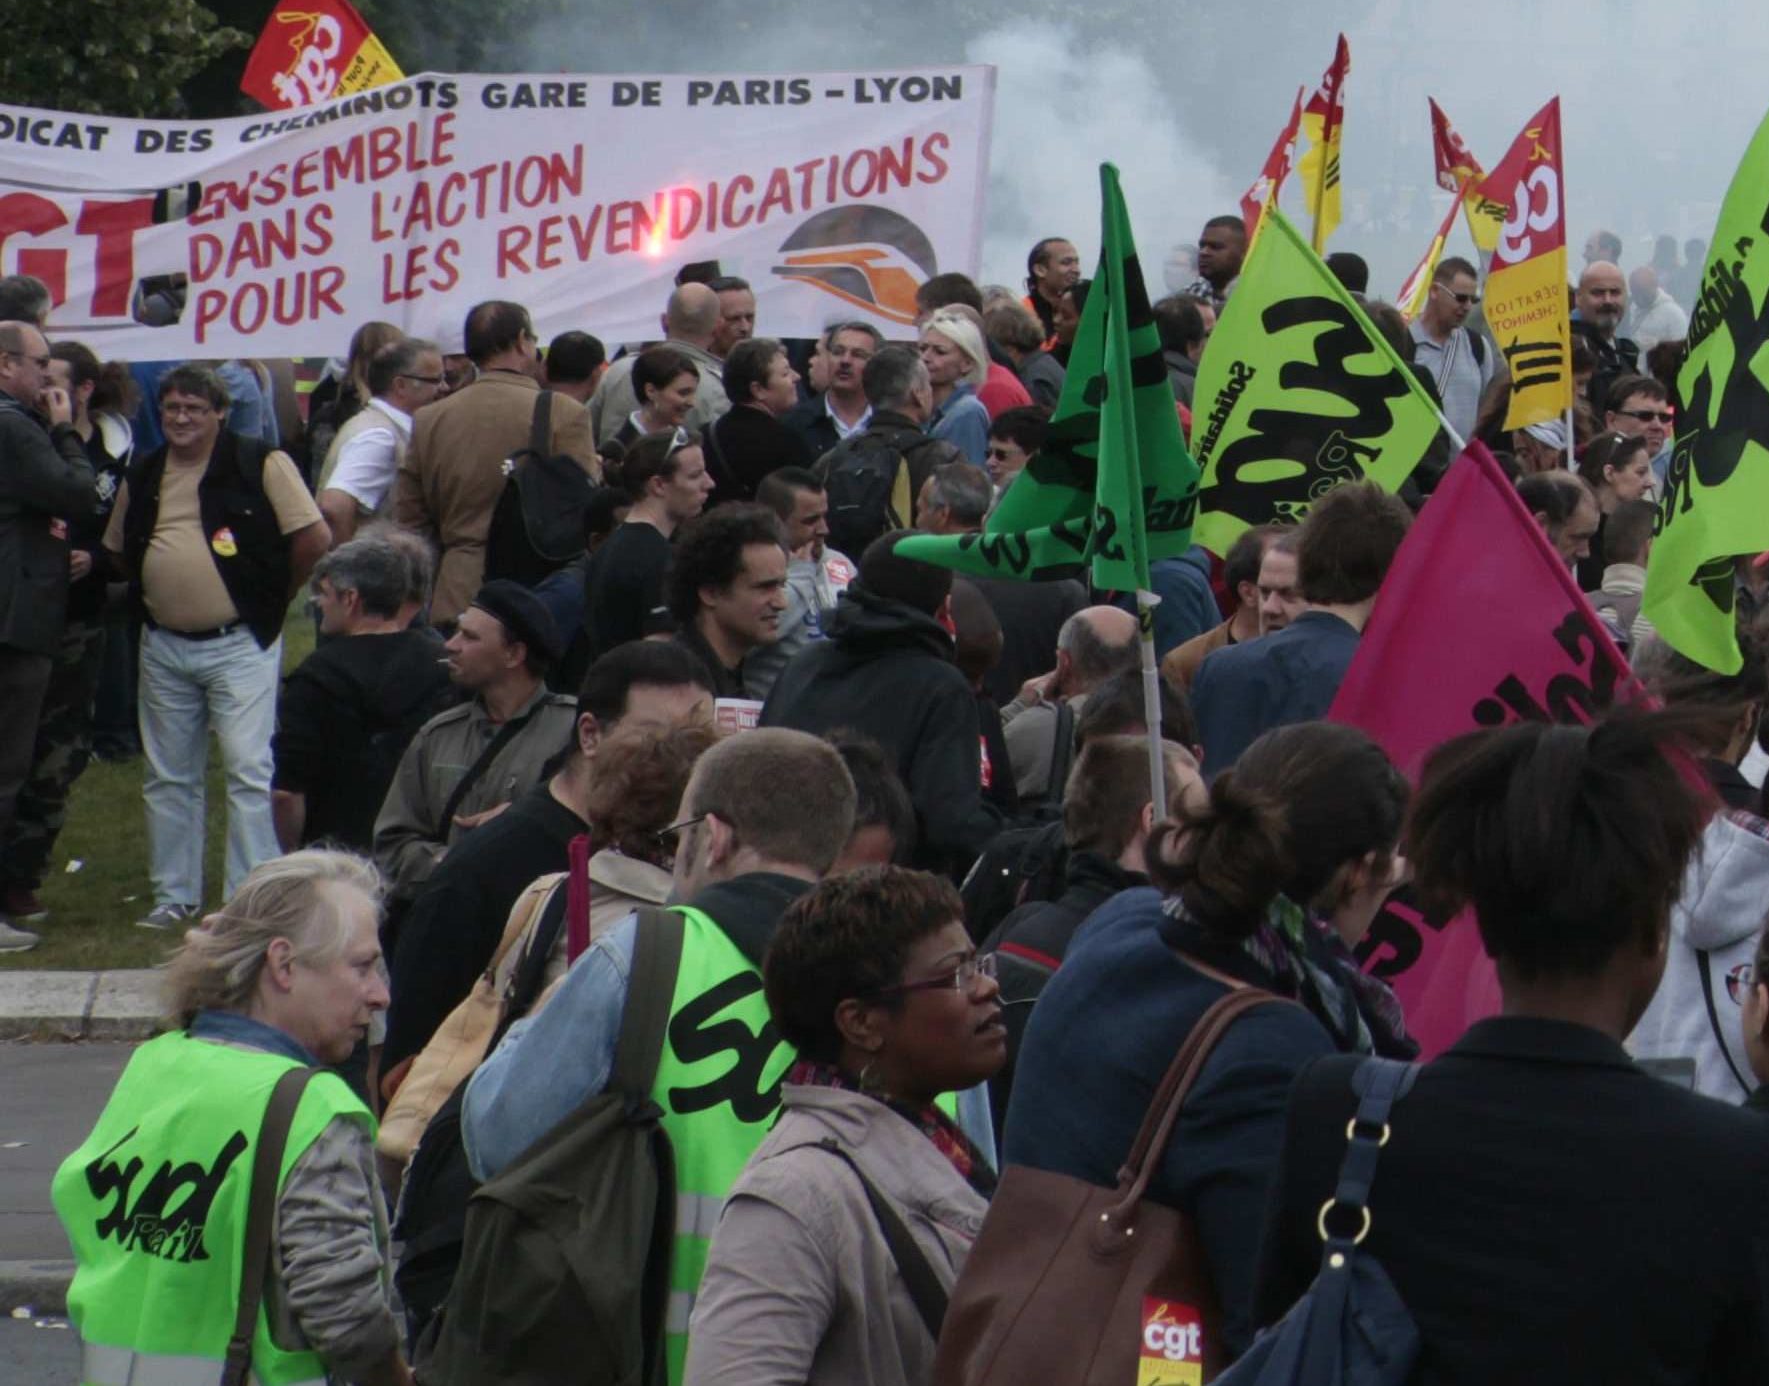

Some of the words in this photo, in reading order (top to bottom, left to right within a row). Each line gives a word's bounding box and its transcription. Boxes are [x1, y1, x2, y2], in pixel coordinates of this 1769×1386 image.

[134, 128, 214, 154] DES
[238, 80, 459, 144] CHEMINOTS
[481, 82, 588, 109] GARE
[611, 80, 662, 107] DE
[187, 112, 457, 227] ENSEMBLE
[188, 202, 334, 283] DANS
[371, 143, 584, 244] L'ACTION
[193, 265, 346, 344] POUR
[382, 238, 460, 304] LES
[497, 131, 951, 279] REVENDICATIONS
[667, 969, 798, 1124] Su
[125, 1213, 211, 1264] Rail
[1143, 1322, 1201, 1361] cgt
